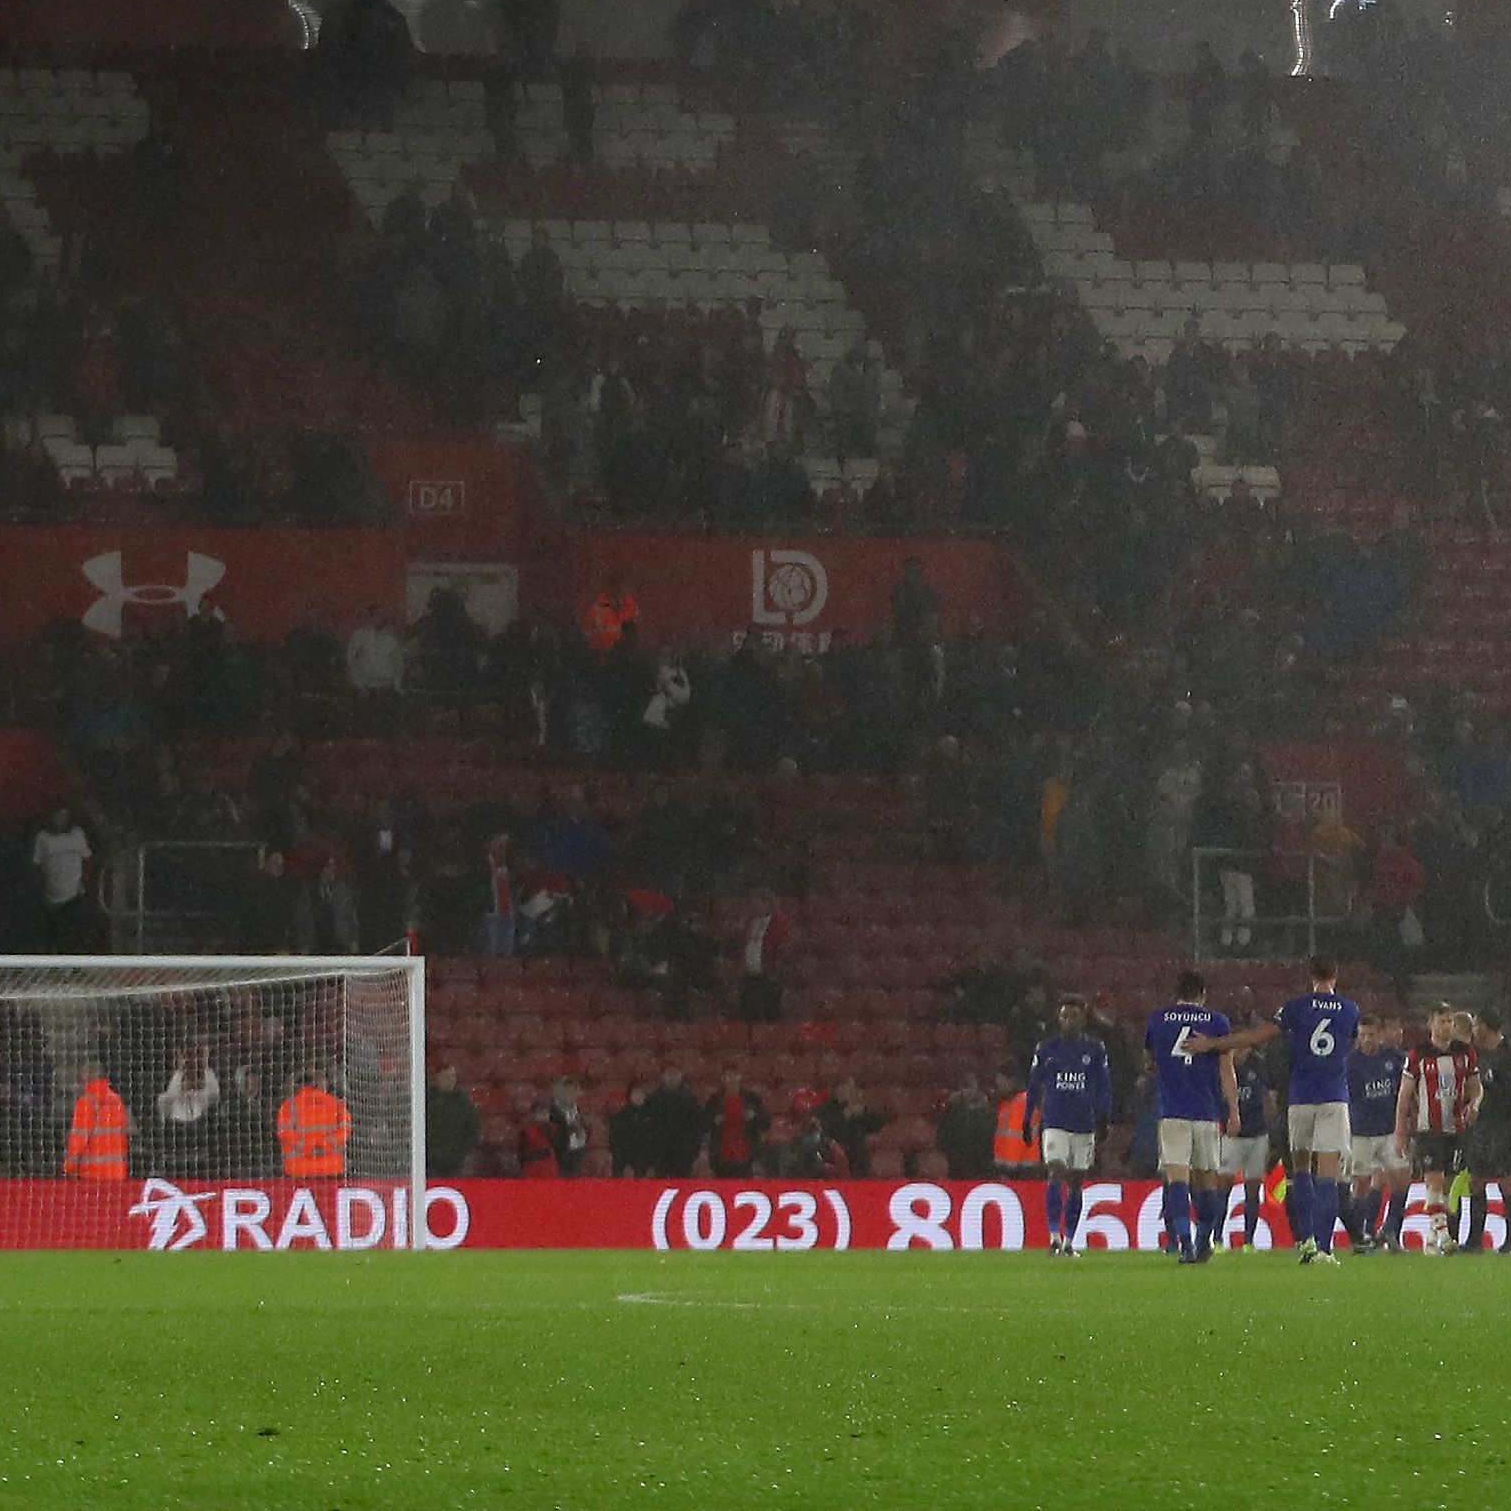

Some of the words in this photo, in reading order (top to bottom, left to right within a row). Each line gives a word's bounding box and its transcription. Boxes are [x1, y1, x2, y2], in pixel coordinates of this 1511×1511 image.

[1312, 999, 1342, 1010] EVANS
[1171, 1025, 1193, 1065] 4
[1310, 1018, 1335, 1057] 6
[1056, 1072, 1086, 1082] KING
[222, 1186, 470, 1251] RADIO
[651, 1189, 852, 1251] (023)
[887, 1182, 1025, 1251] 80
